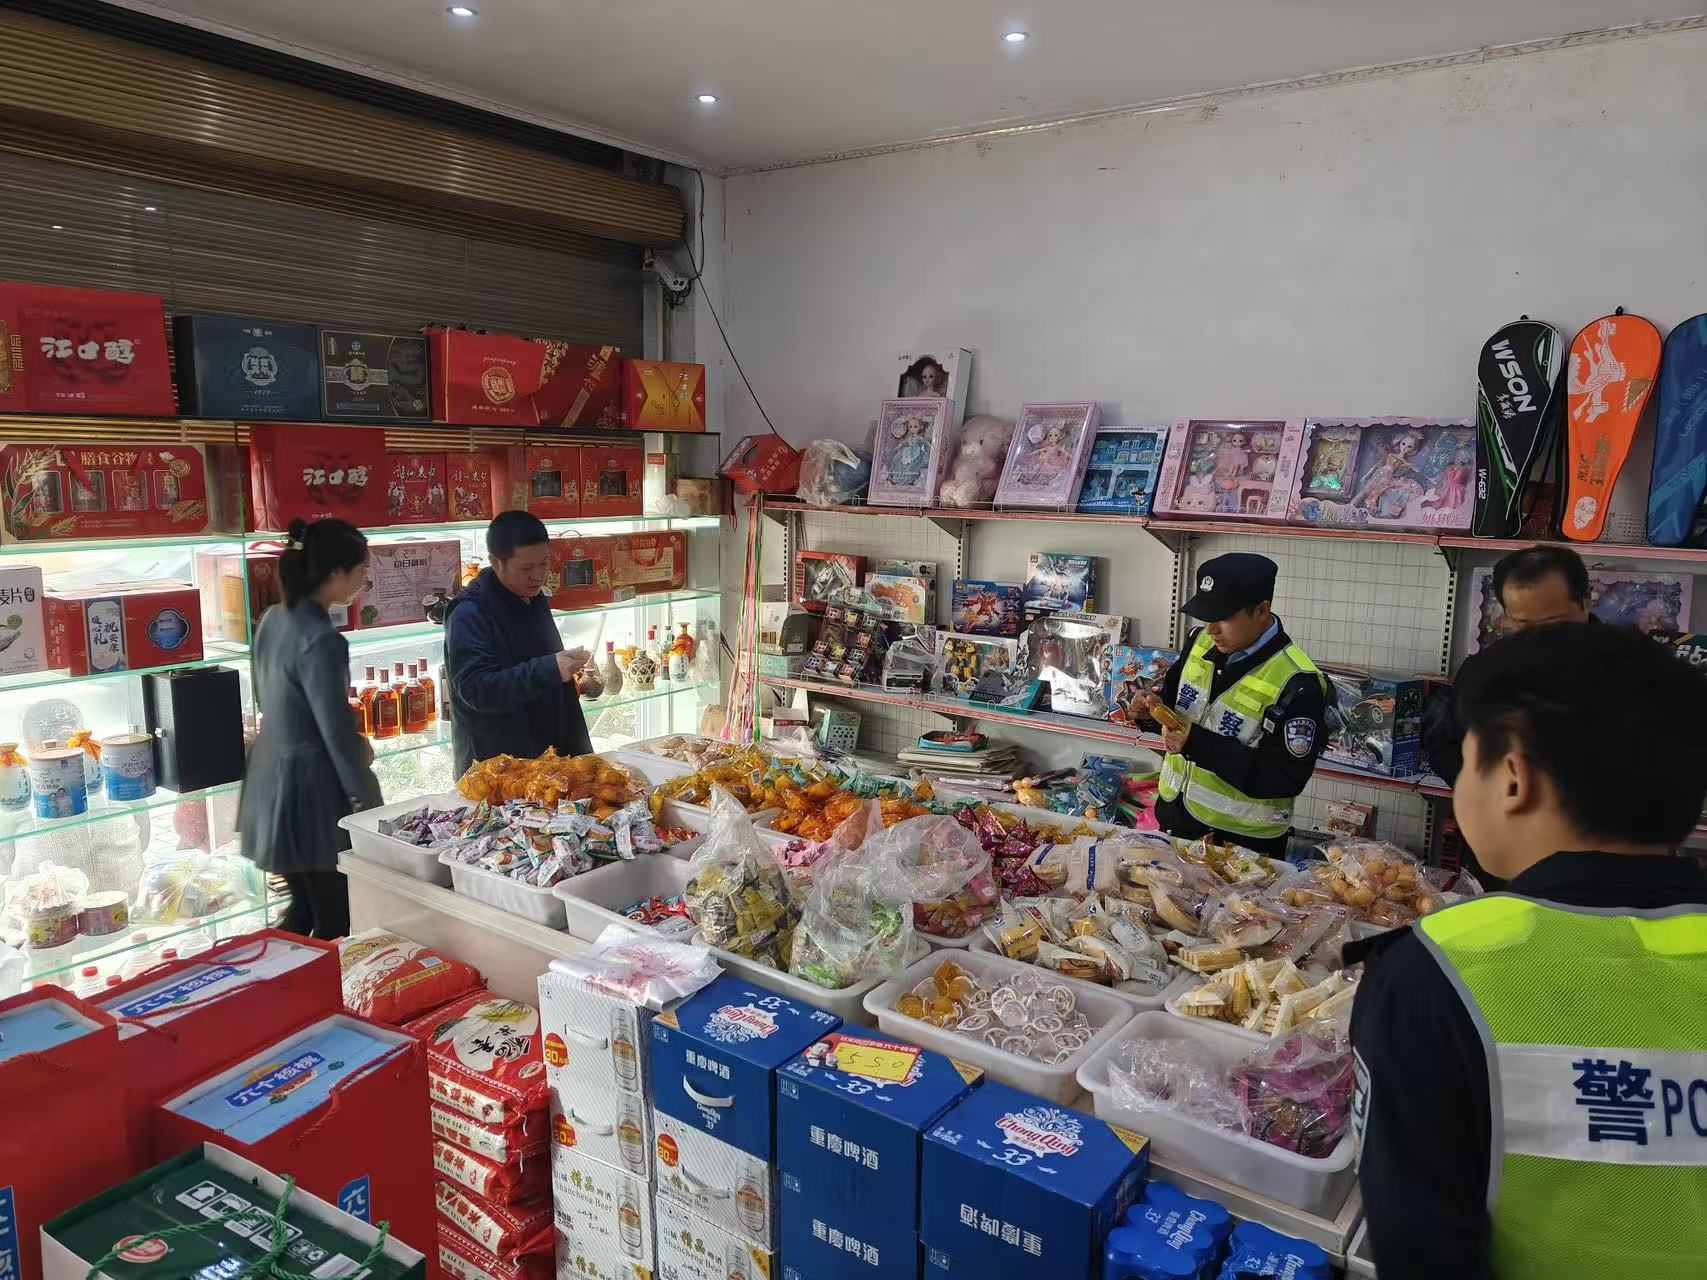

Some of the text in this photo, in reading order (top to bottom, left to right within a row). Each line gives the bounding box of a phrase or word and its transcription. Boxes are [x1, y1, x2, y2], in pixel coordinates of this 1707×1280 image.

[1491, 338, 1537, 413] WSON
[233, 1055, 319, 1104] 六个核桃
[836, 1079, 874, 1096] 33
[1571, 1057, 1656, 1146] 警
[992, 1148, 1033, 1167] 33
[996, 1116, 1077, 1155] ChongQing
